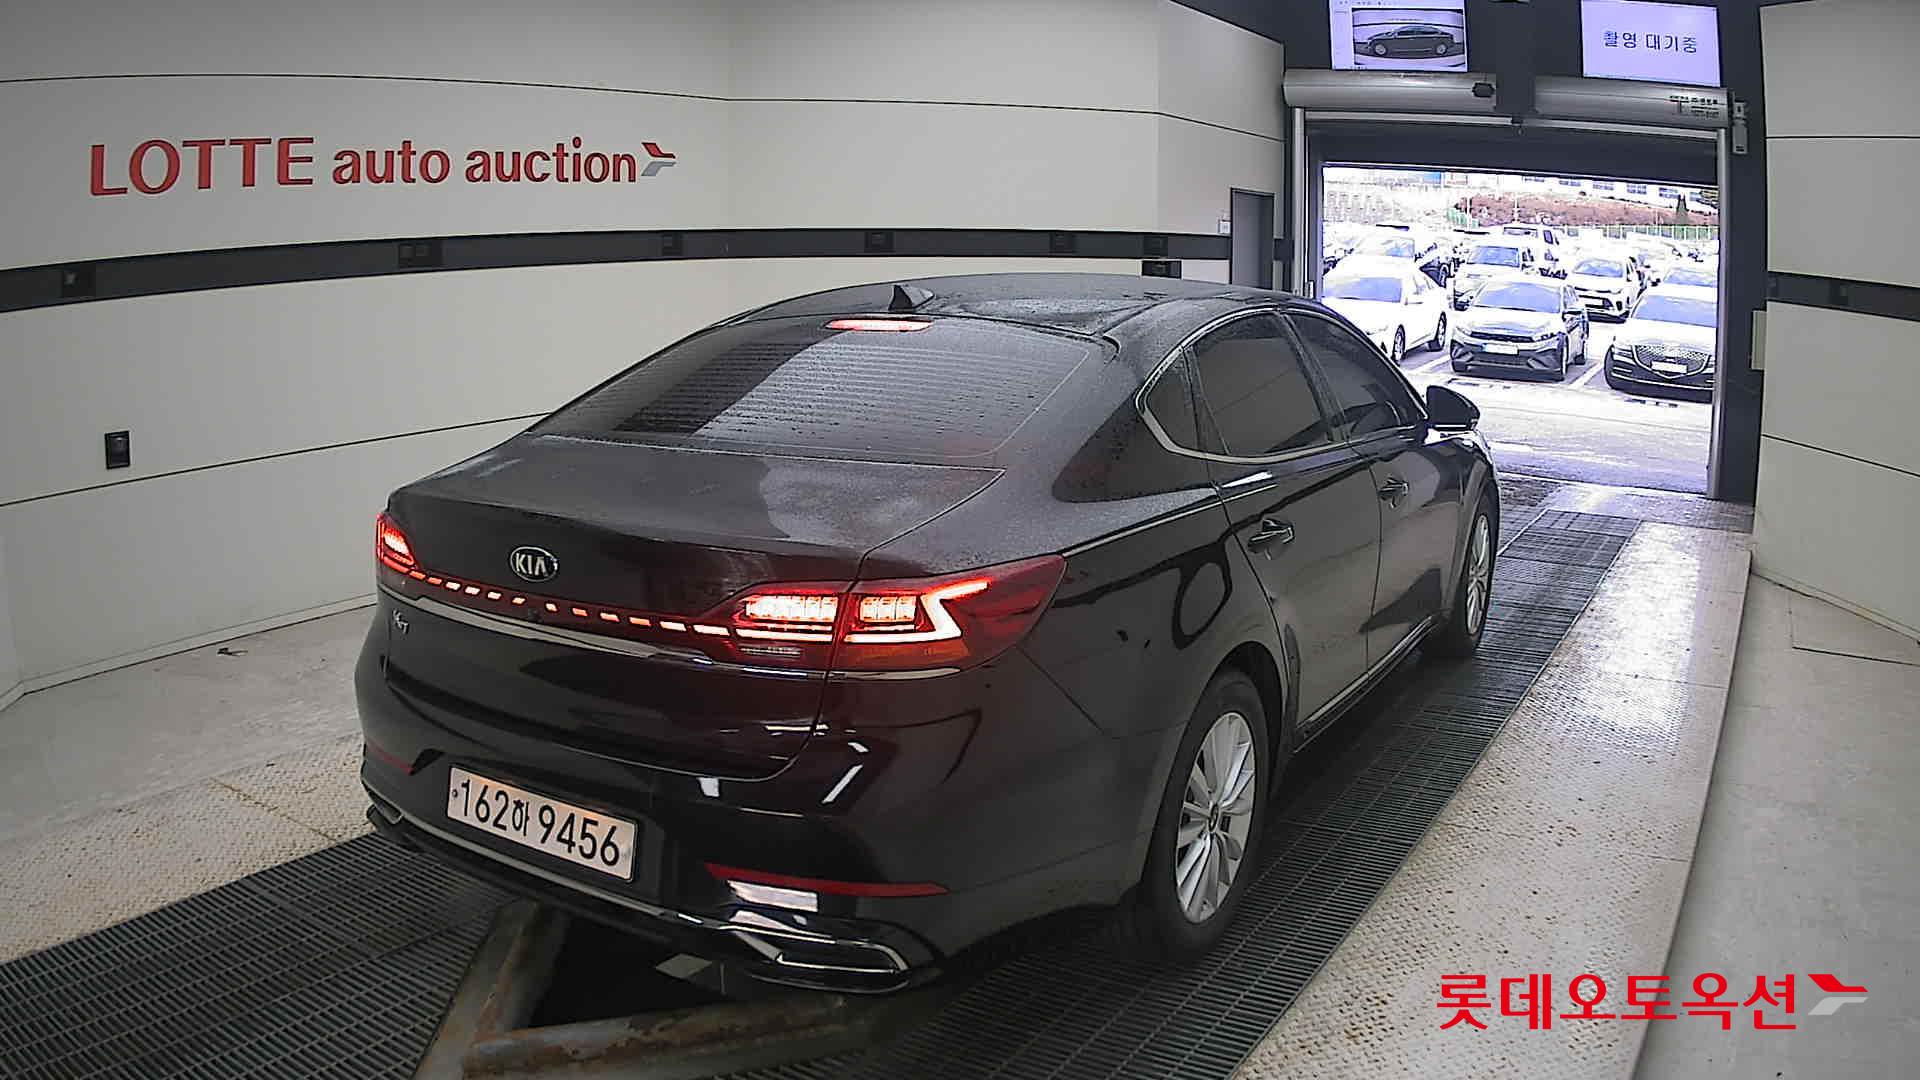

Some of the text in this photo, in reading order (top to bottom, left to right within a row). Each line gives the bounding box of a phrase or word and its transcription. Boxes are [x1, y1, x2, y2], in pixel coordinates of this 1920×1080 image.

[1645, 33, 1697, 54] 대기중
[90, 136, 637, 196] LOTTE auto auction
[538, 803, 621, 868] 9456
